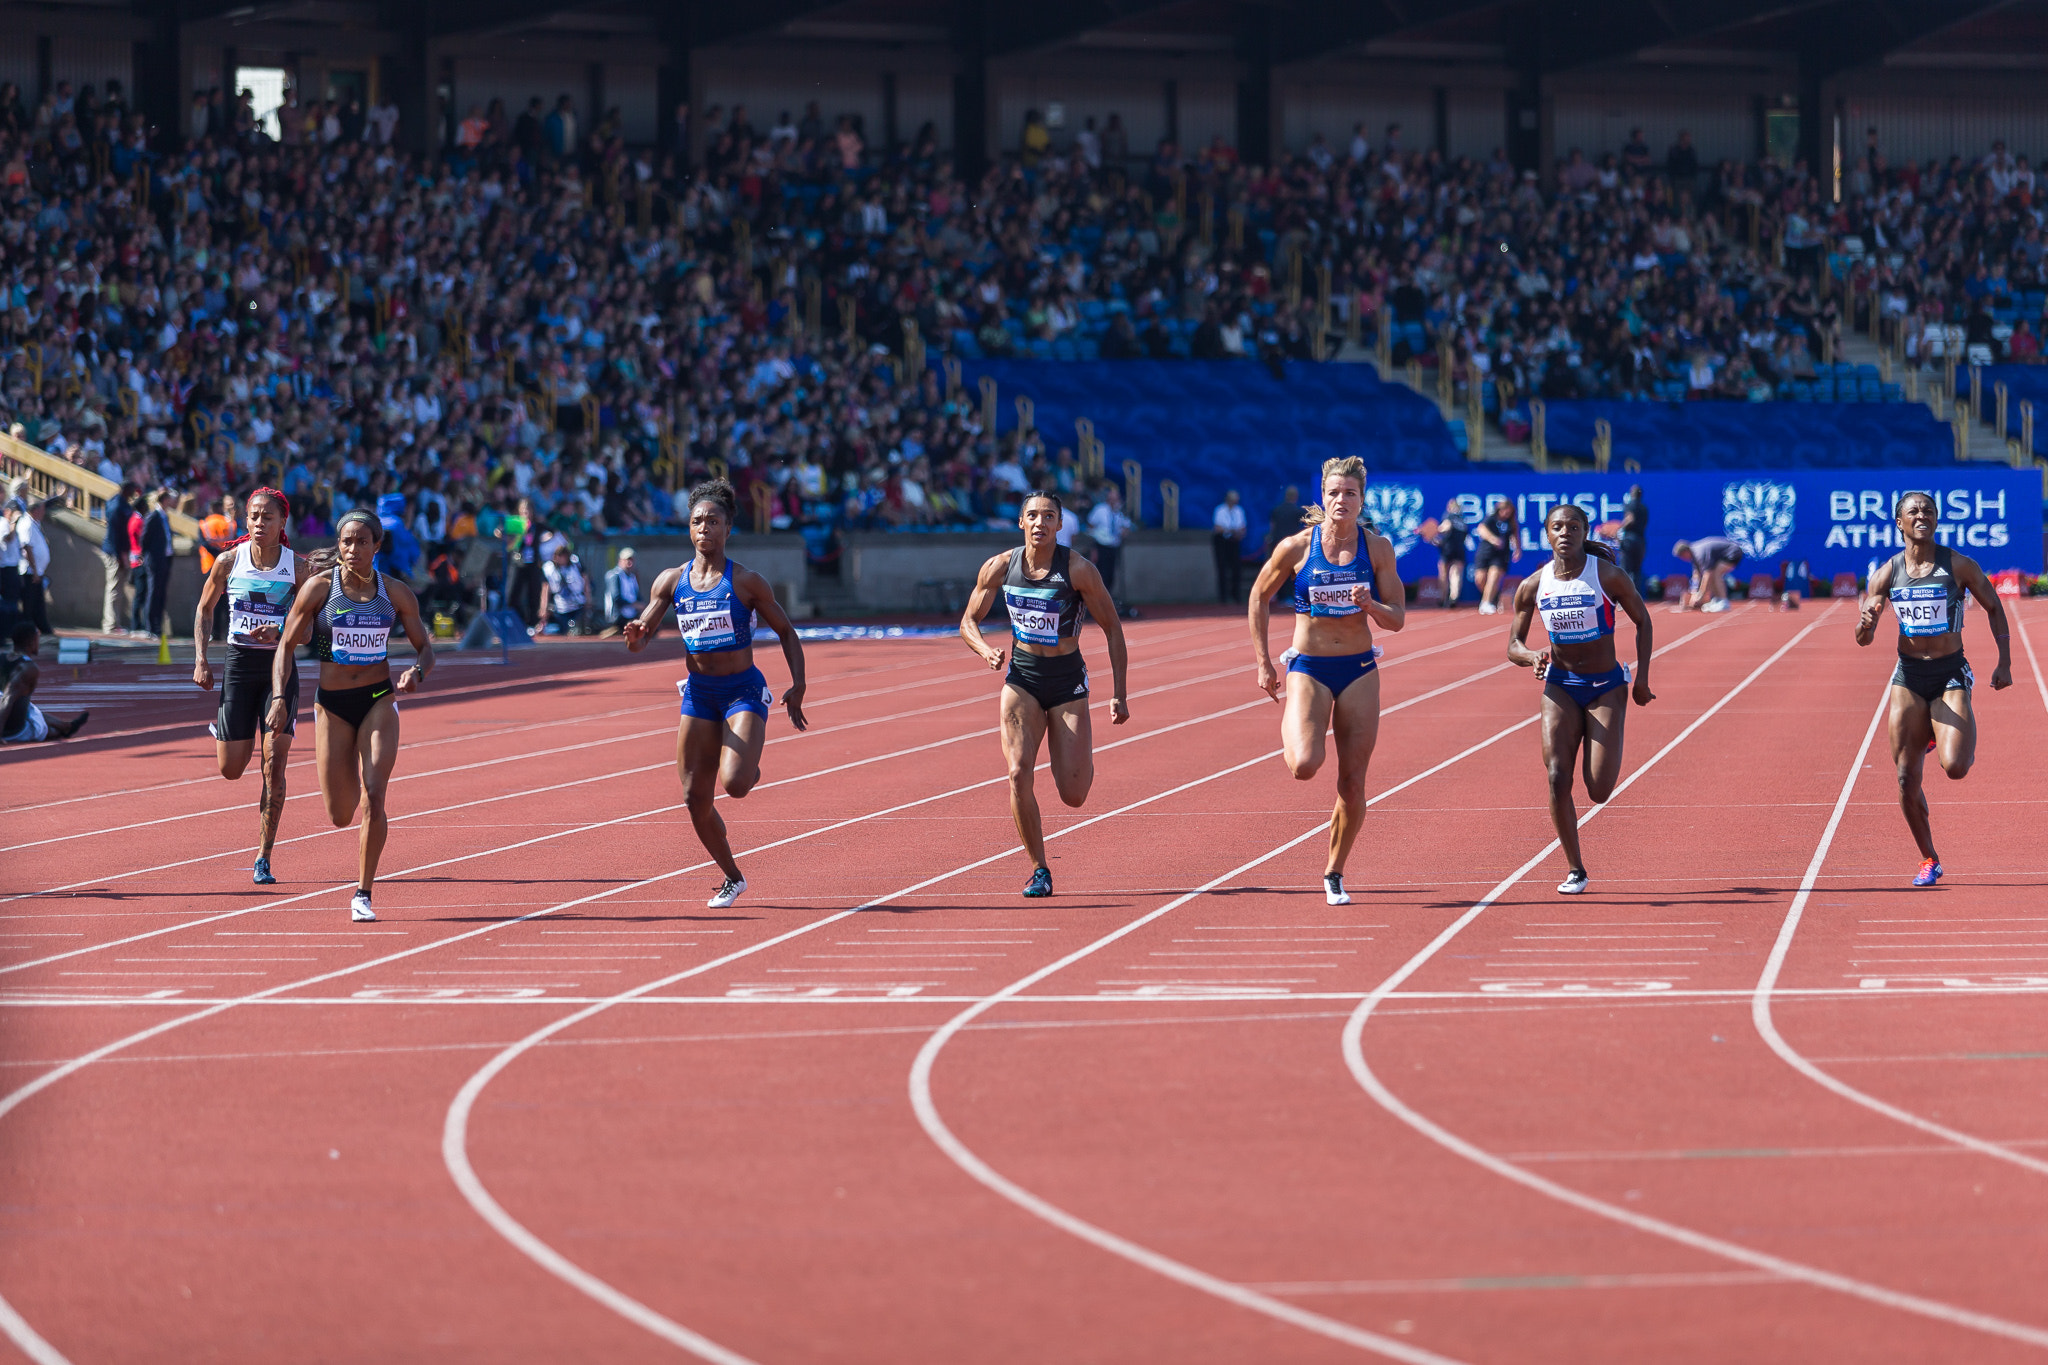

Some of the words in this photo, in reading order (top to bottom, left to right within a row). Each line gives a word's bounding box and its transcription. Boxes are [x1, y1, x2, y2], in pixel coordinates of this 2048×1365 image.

[1830, 489, 2006, 521] BRIISH
[1824, 523, 2010, 548] ATHLTICS
[1313, 590, 1353, 602] SCHIPPE
[1026, 598, 1047, 606] BRITISH
[1550, 610, 1585, 621] ASHER
[1898, 605, 1941, 620] FACEY
[680, 616, 730, 633] BARTOLETTA
[1010, 610, 1055, 630] NELSON
[1553, 621, 1584, 631] SMITH
[1908, 626, 1947, 634] Birmingham
[336, 632, 386, 648] GARDNER
[1020, 632, 1056, 643] Birmingham
[1560, 631, 1598, 640] Birmingham
[694, 636, 733, 647] Birmingham
